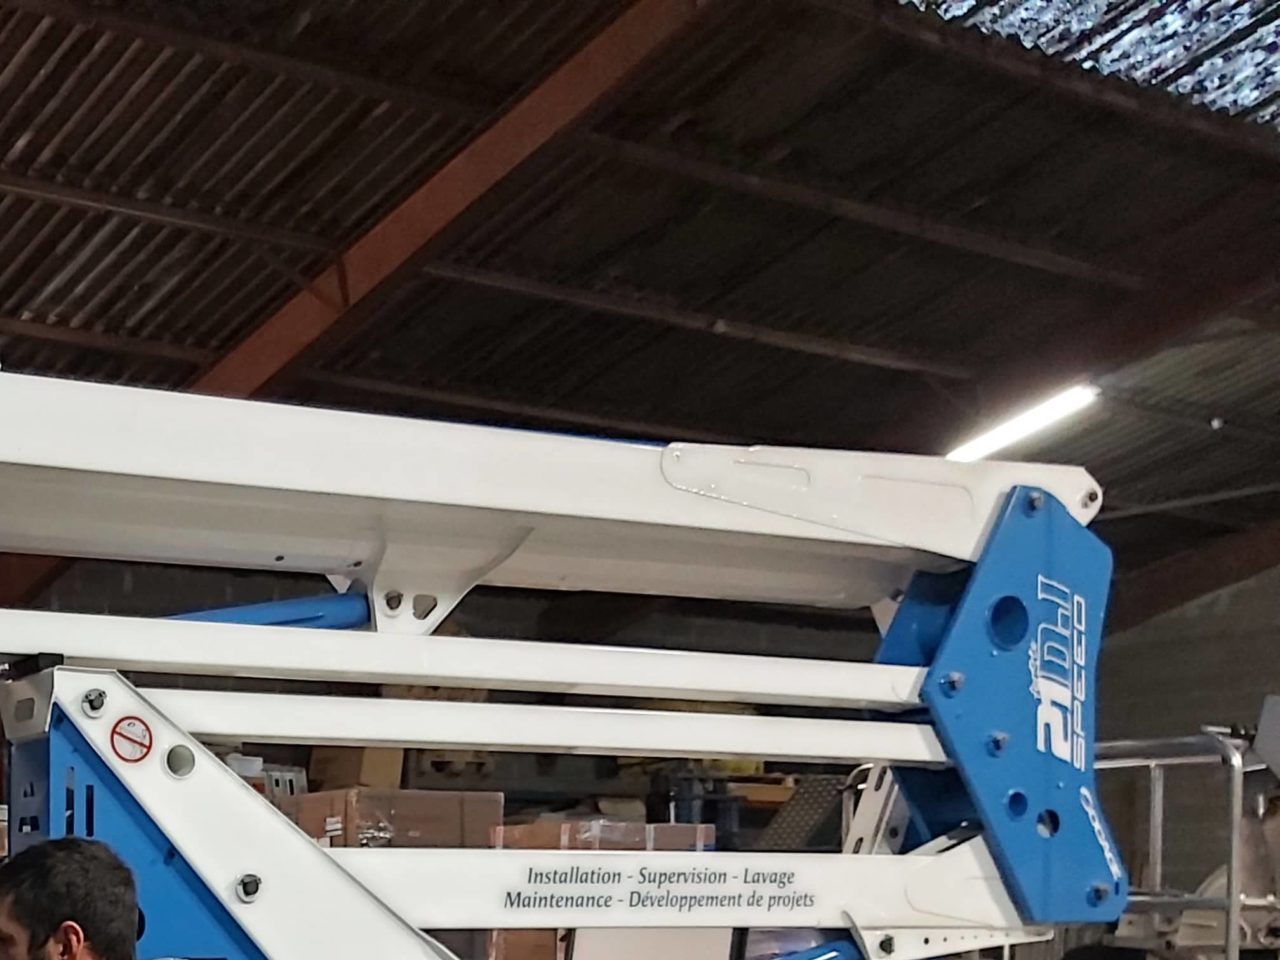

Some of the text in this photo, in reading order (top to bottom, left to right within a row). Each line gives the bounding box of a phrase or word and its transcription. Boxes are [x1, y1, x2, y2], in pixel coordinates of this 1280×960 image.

[1072, 594, 1087, 773] SPEED
[527, 867, 622, 885] Installation
[638, 867, 727, 888] Supervision
[743, 868, 795, 888] Lavage
[504, 891, 612, 908] Maintenance
[629, 890, 742, 912] Développement
[746, 891, 763, 907] de
[767, 892, 815, 911] projets
